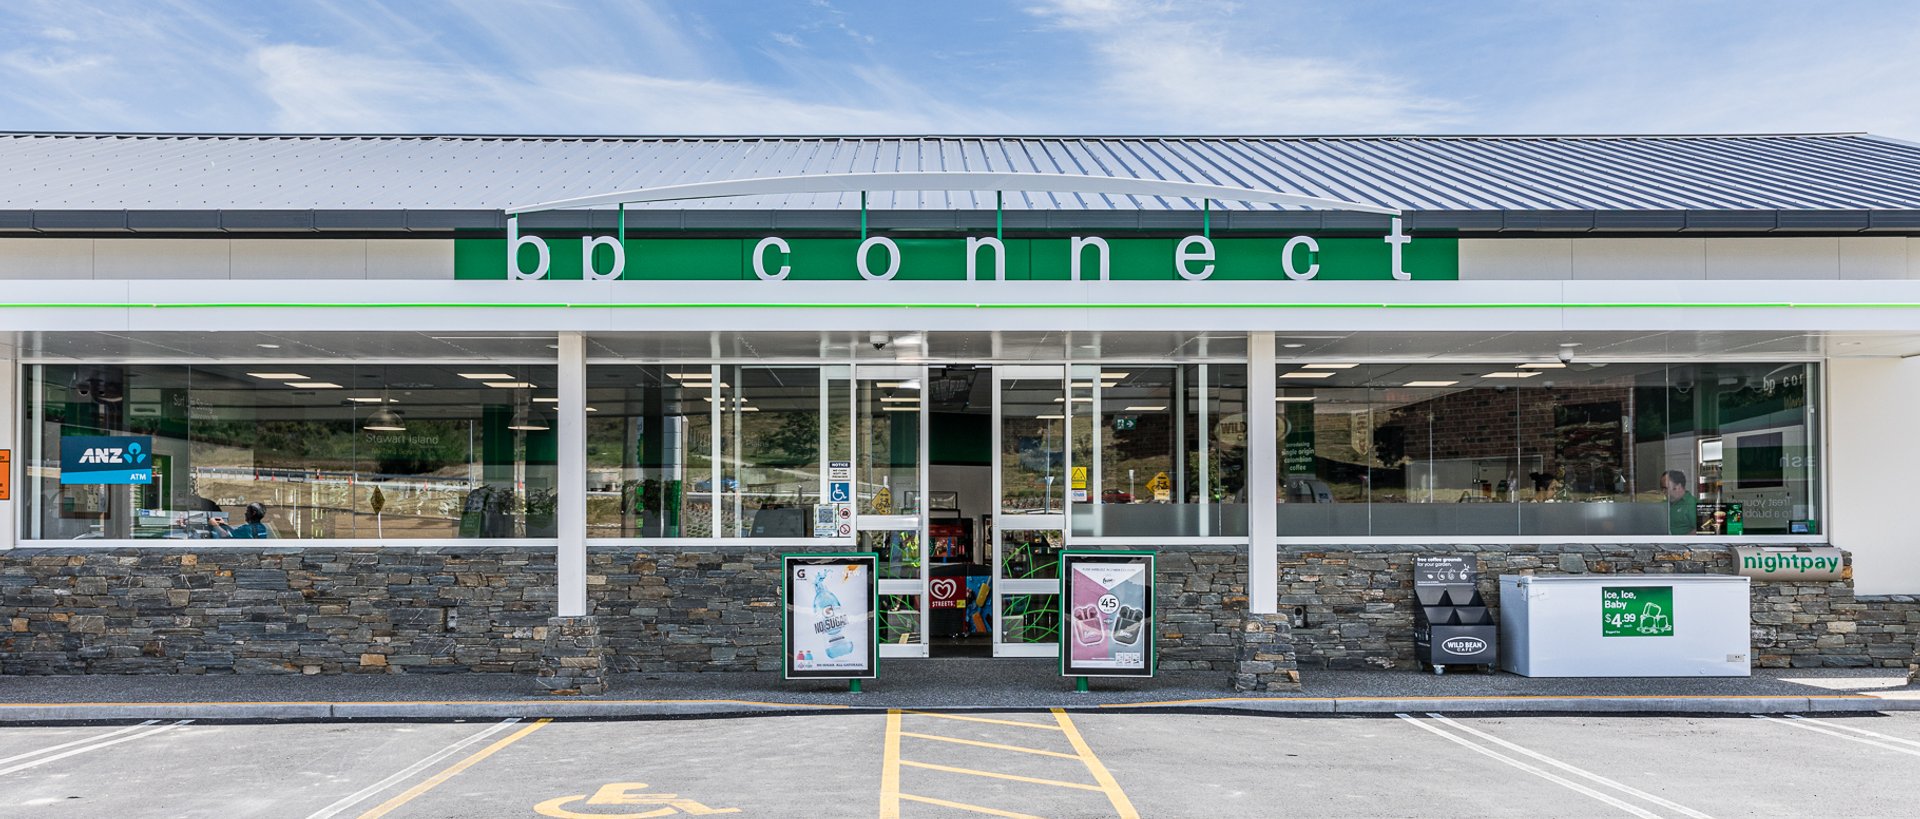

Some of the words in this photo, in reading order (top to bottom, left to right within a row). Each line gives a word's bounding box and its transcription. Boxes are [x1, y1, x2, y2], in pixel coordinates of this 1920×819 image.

[507, 217, 626, 281] bp
[752, 217, 1412, 281] connect
[409, 434, 439, 445] Island
[79, 448, 123, 464] ANZ
[1743, 552, 1839, 573] nightpay
[1604, 590, 1620, 599] Ice,
[1621, 590, 1637, 599] Ice,
[1604, 600, 1627, 610] Baby
[814, 621, 824, 634] NO
[1604, 613, 1636, 628] $4.99
